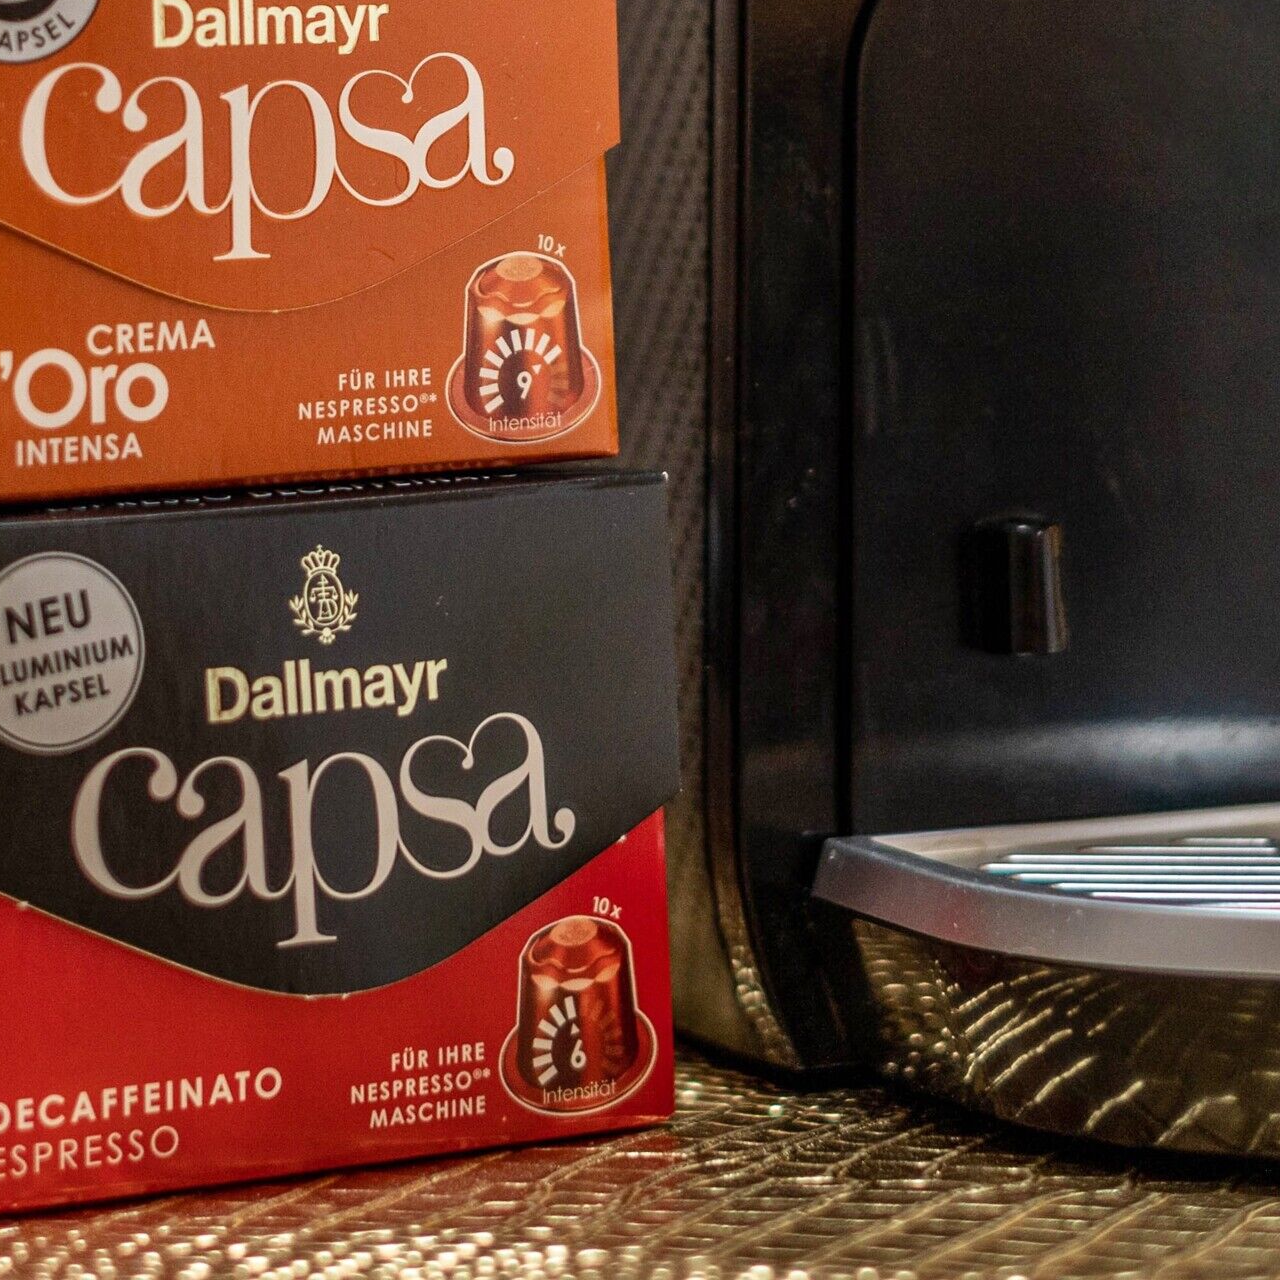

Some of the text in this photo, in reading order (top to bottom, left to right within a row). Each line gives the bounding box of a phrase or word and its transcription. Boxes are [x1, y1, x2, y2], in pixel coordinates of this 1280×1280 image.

[86, 318, 216, 357] CREMA
[337, 367, 432, 392] FÜR IHRE
[517, 371, 532, 400] 9
[316, 419, 433, 445] MASCHINE
[489, 411, 563, 433] Intensität
[15, 432, 144, 467] INTENSA
[4, 588, 92, 645] NEU
[14, 673, 111, 716] KAPSEL
[205, 657, 448, 724] Dallmayr
[391, 1041, 486, 1072] FÜR IHRE
[570, 1039, 587, 1070] 6
[542, 1081, 617, 1105] Intensität
[369, 1095, 487, 1129] MASCHINE
